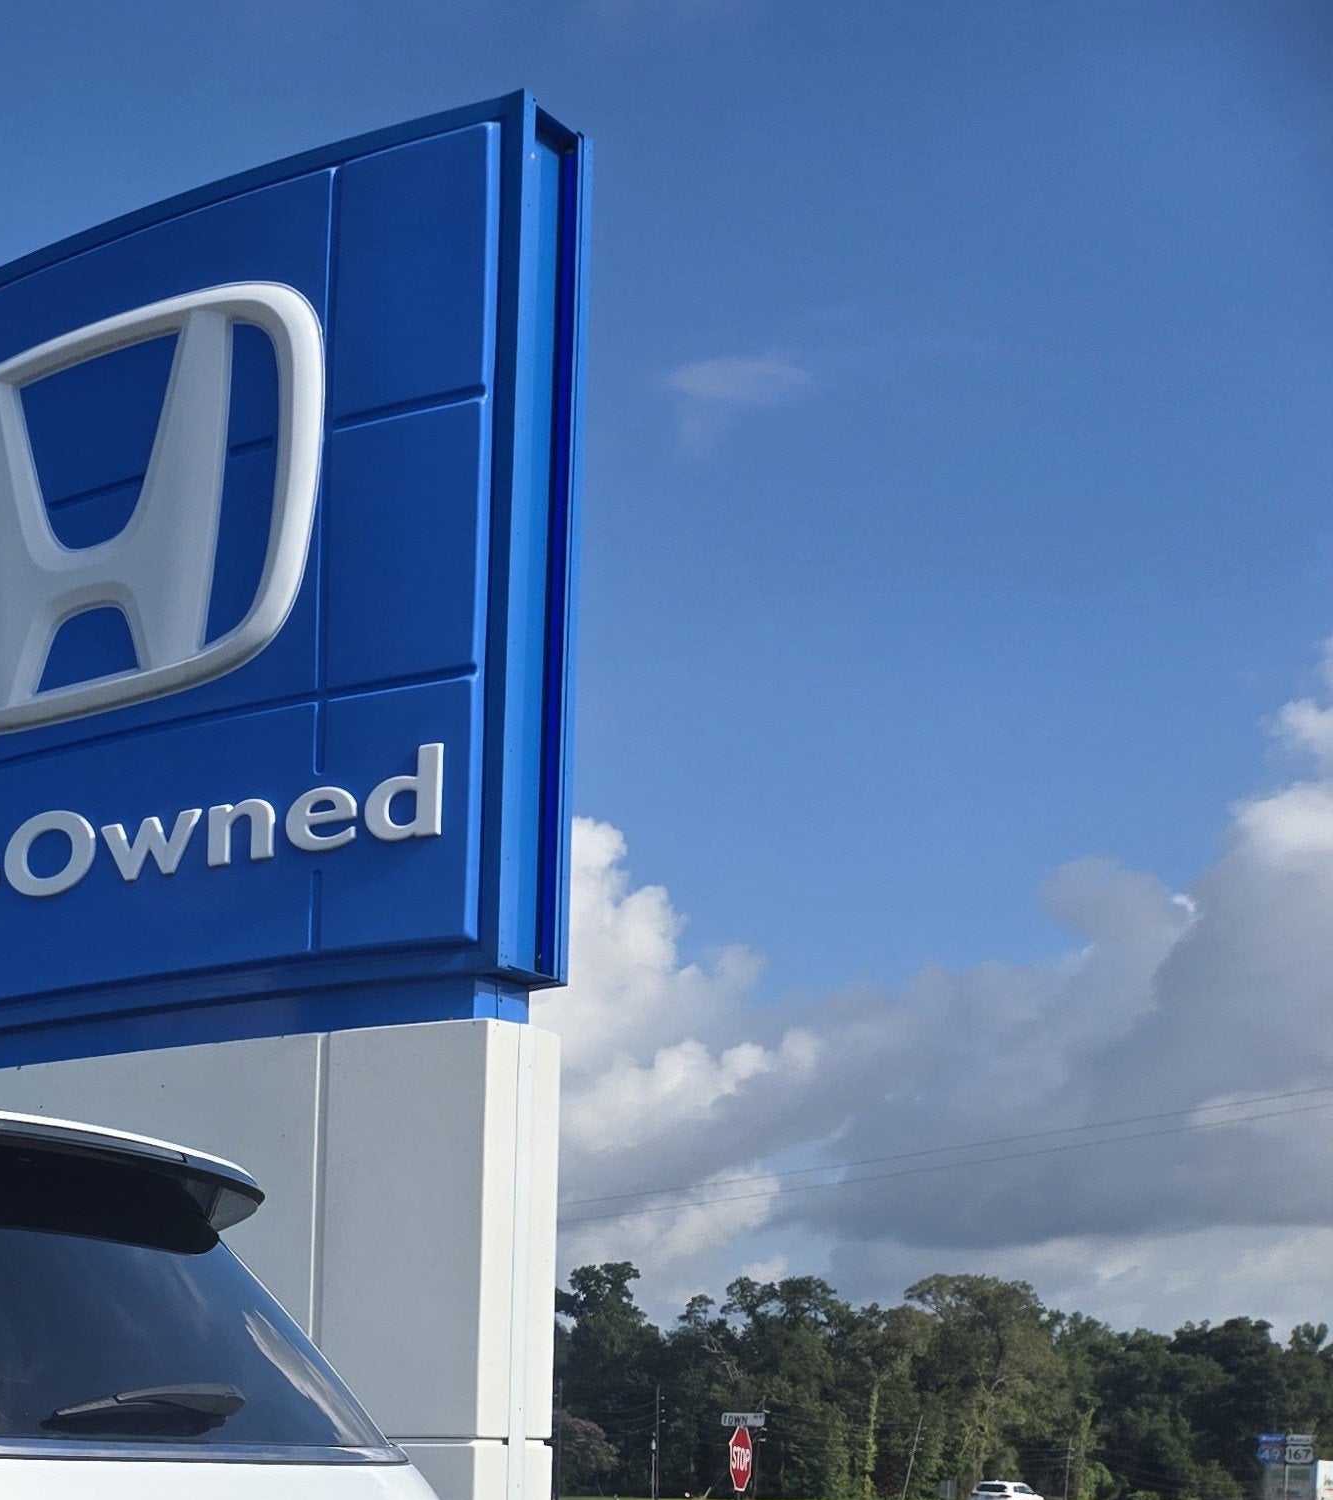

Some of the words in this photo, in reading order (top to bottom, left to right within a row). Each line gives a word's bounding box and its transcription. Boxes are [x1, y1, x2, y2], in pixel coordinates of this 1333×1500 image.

[723, 1415, 748, 1425] TOWN
[732, 1445, 751, 1472] STOP
[1288, 1448, 1311, 1461] 167
